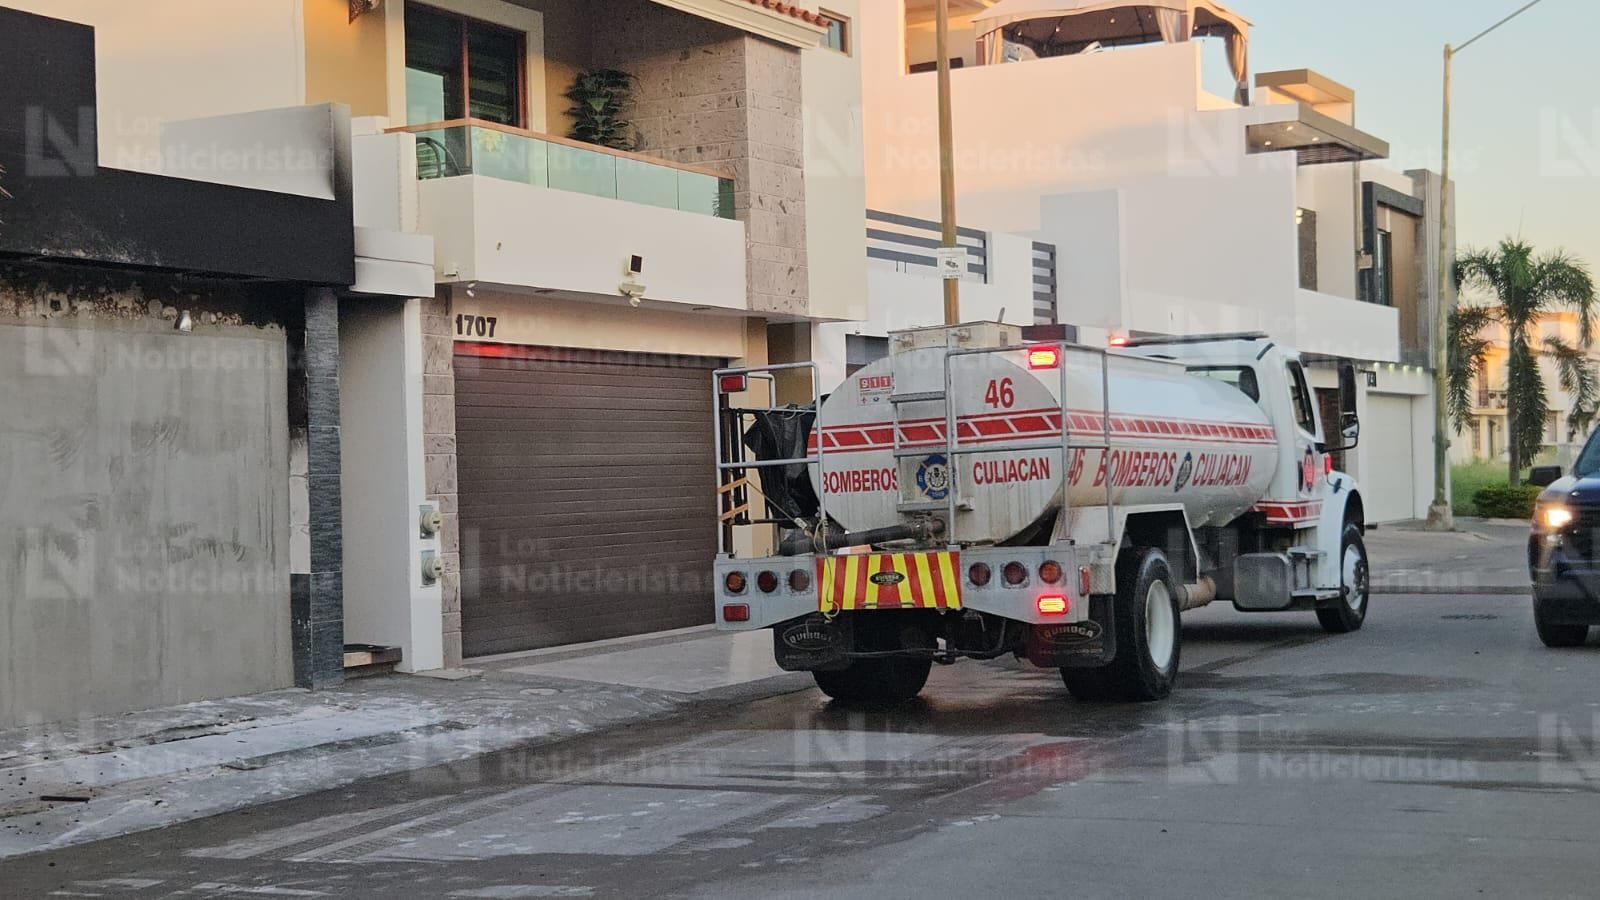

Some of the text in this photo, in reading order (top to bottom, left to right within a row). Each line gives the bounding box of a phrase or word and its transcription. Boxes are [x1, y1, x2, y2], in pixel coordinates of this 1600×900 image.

[455, 313, 497, 338] 1707
[860, 376, 891, 389] 911
[984, 377, 1015, 409] 46
[973, 457, 1051, 485] CULIACAN
[1067, 448, 1253, 488] 46 BOMBEROS CULIACAN
